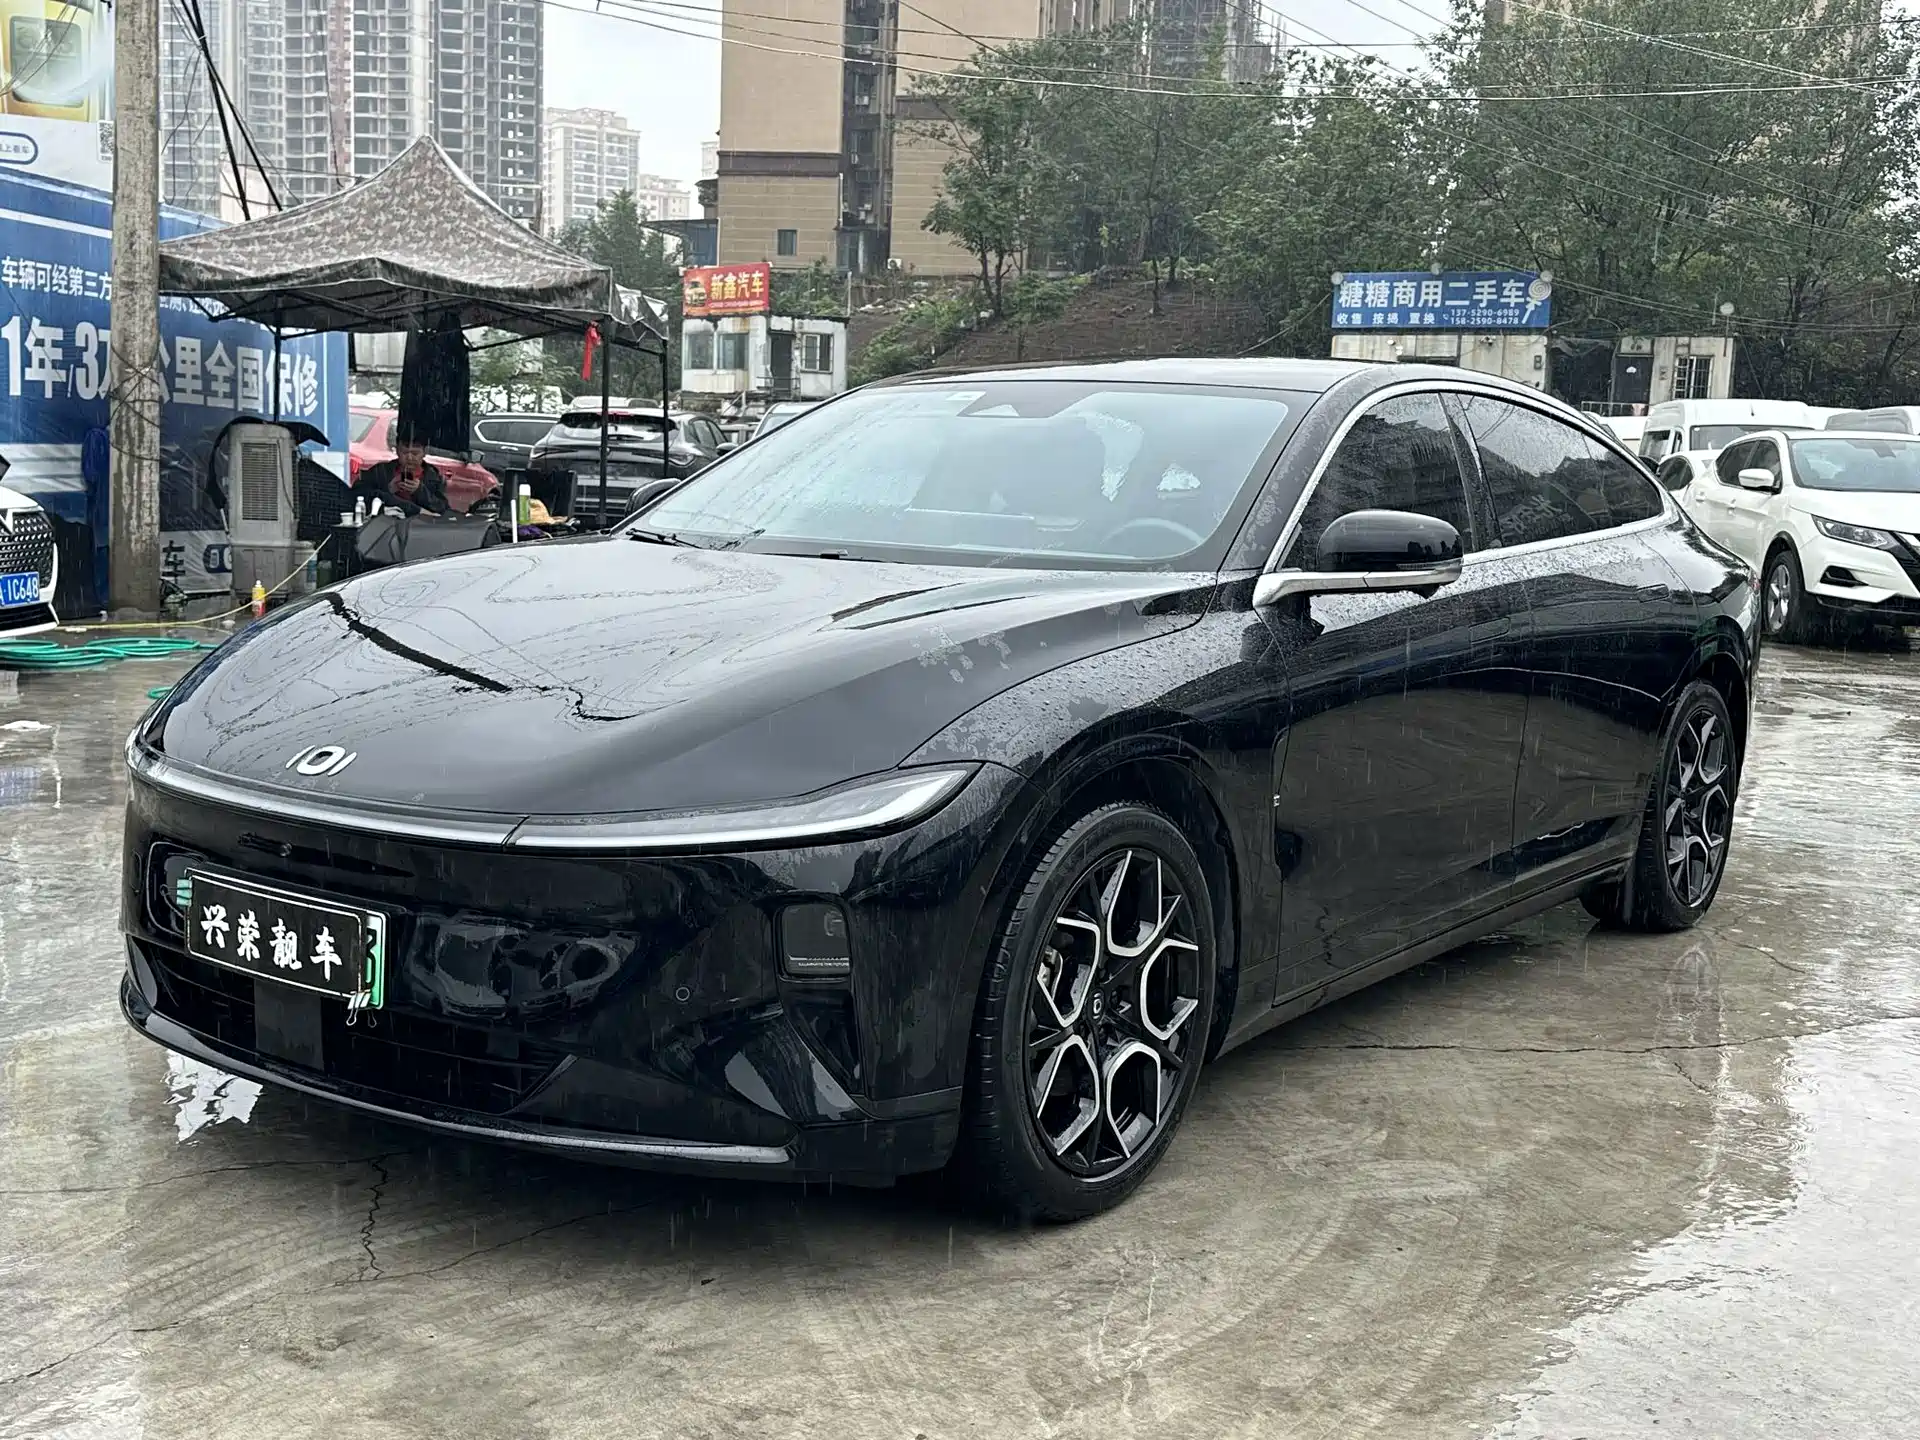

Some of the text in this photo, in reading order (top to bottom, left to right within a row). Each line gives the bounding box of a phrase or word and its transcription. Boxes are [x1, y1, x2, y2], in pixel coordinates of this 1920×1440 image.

[1, 256, 112, 300] 车辆可经第三方
[711, 270, 764, 300] 新鑫汽车
[1338, 279, 1525, 308] 糖糖商用二手车
[1336, 312, 1435, 325] 收售 按揭 置换
[1451, 309, 1519, 317] 137-5290-6989
[1451, 317, 1519, 325] 158-2590-8478
[201, 904, 342, 982] 兴荣靓车
